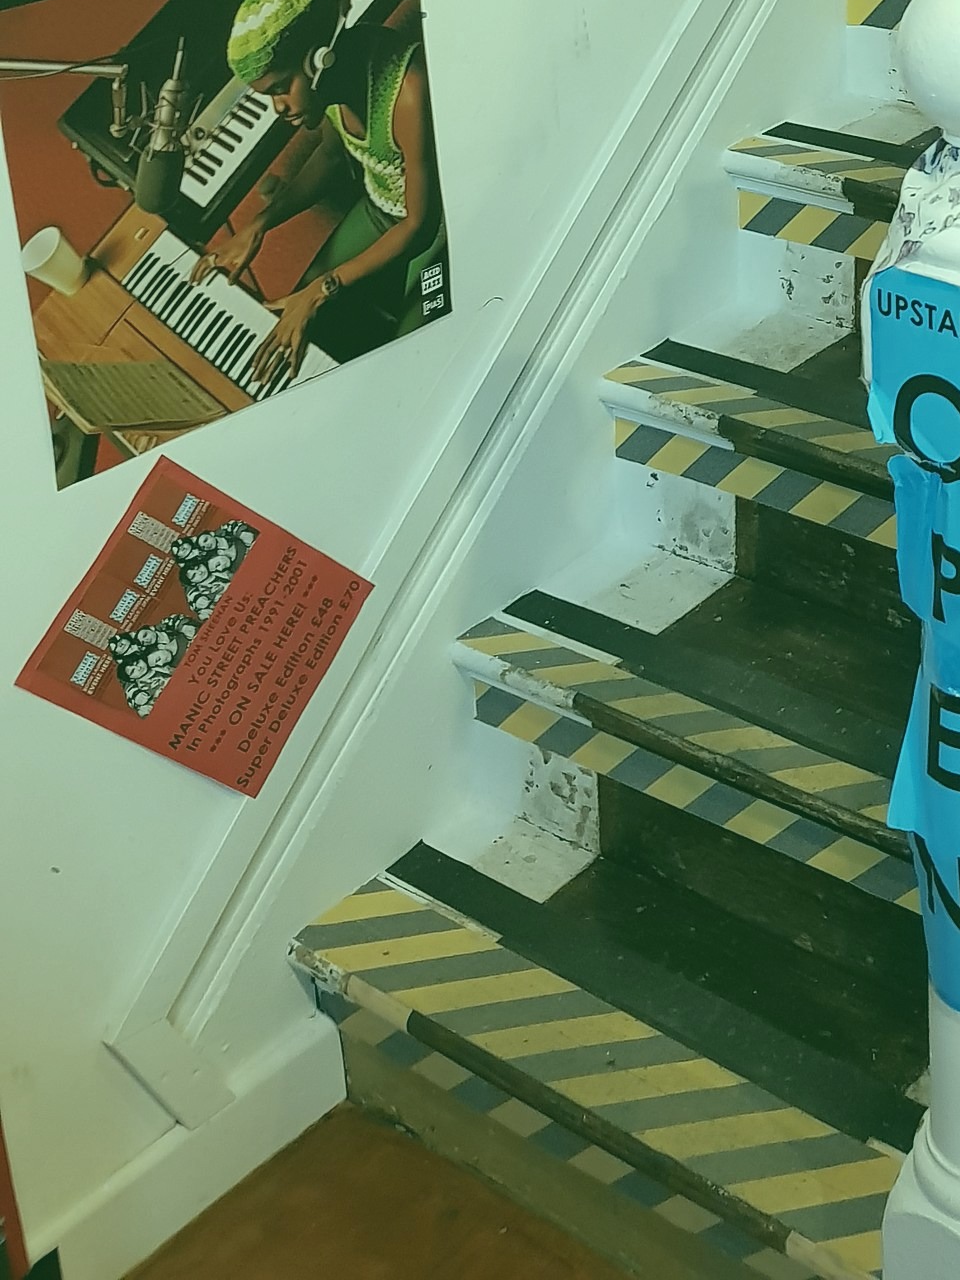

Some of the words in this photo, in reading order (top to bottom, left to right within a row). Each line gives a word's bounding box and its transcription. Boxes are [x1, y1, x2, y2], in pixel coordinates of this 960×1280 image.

[166, 688, 212, 750] MANIC
[204, 635, 245, 689] STREET
[235, 544, 301, 634] PREACHERS
[185, 734, 203, 753] In
[194, 634, 266, 734] Photographs
[255, 558, 310, 634] 1991-2001
[186, 654, 213, 688] You
[207, 613, 239, 653] Love
[232, 589, 254, 614] Us:
[225, 694, 253, 727] ON
[244, 649, 280, 694] SALE
[271, 601, 309, 650] HERE!
[234, 689, 283, 754] Deluxe
[272, 628, 318, 689] Edition
[308, 596, 335, 629] £48
[234, 735, 276, 789] Super
[265, 671, 312, 734] Deluxe
[301, 611, 346, 670] Edition
[335, 577, 363, 611] £70
